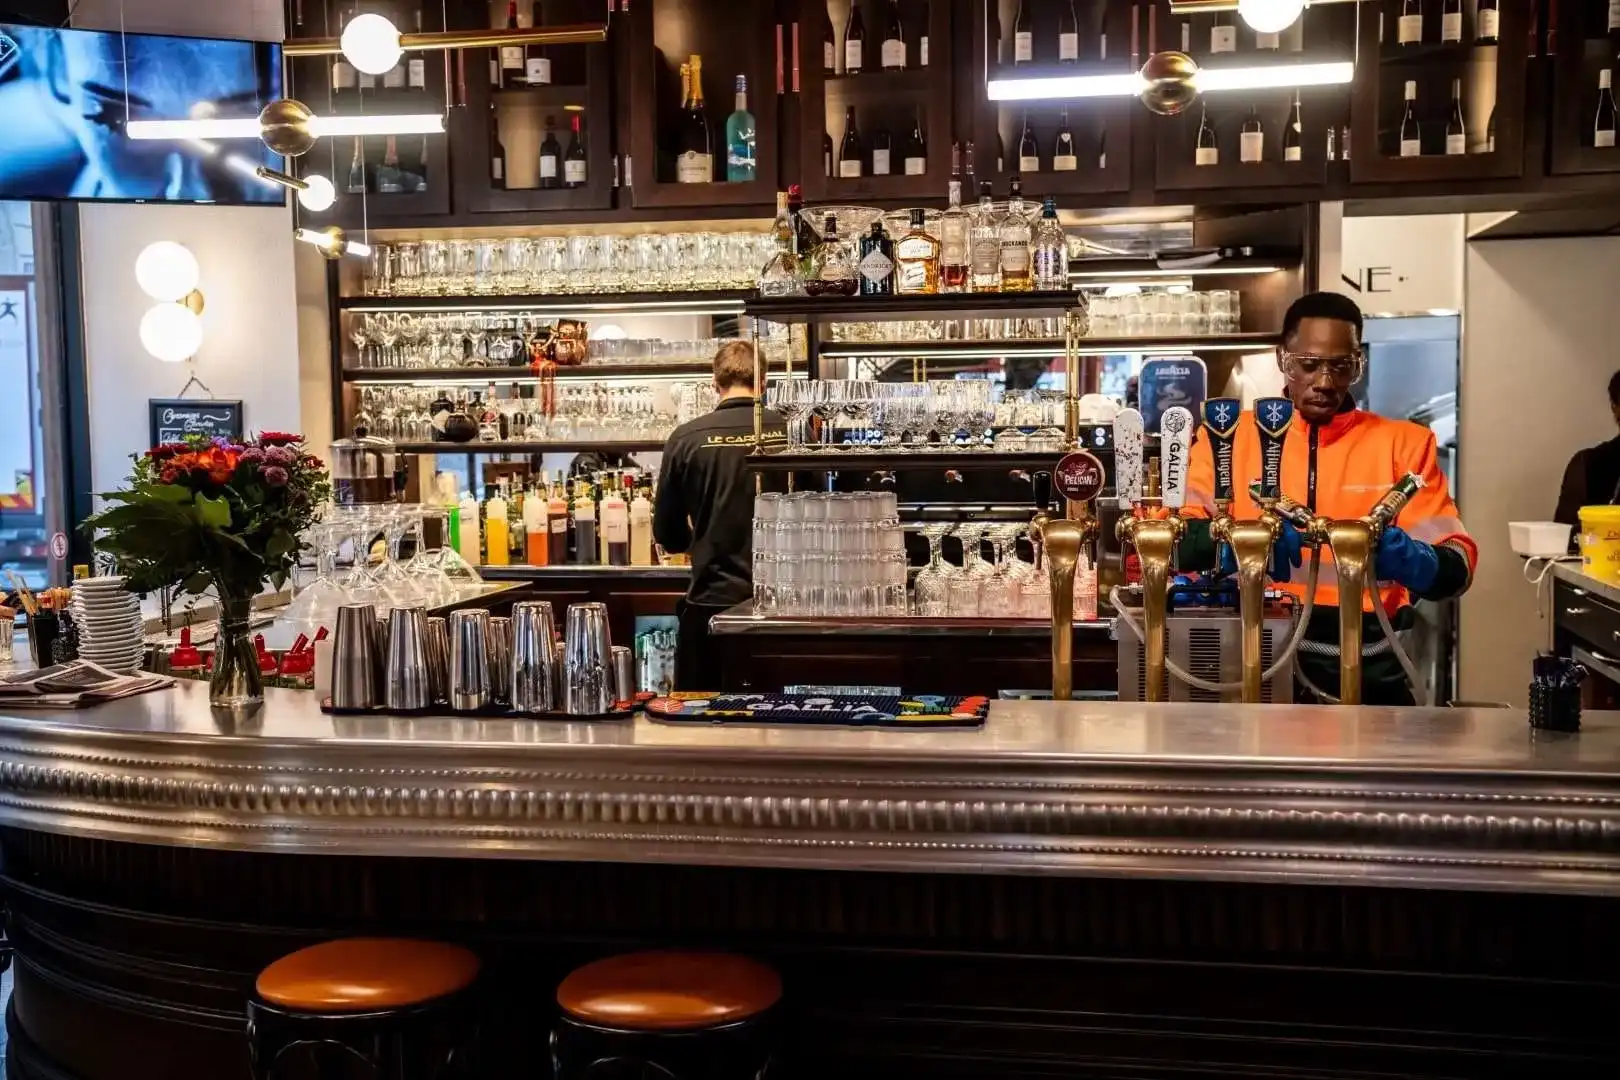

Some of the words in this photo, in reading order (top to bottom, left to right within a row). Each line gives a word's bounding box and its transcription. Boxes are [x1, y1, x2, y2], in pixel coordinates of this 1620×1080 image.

[725, 431, 786, 443] CARDNAL
[1167, 442, 1181, 490] GALLIA
[1064, 473, 1093, 485] PELICAN
[746, 703, 878, 712] GALLIA
